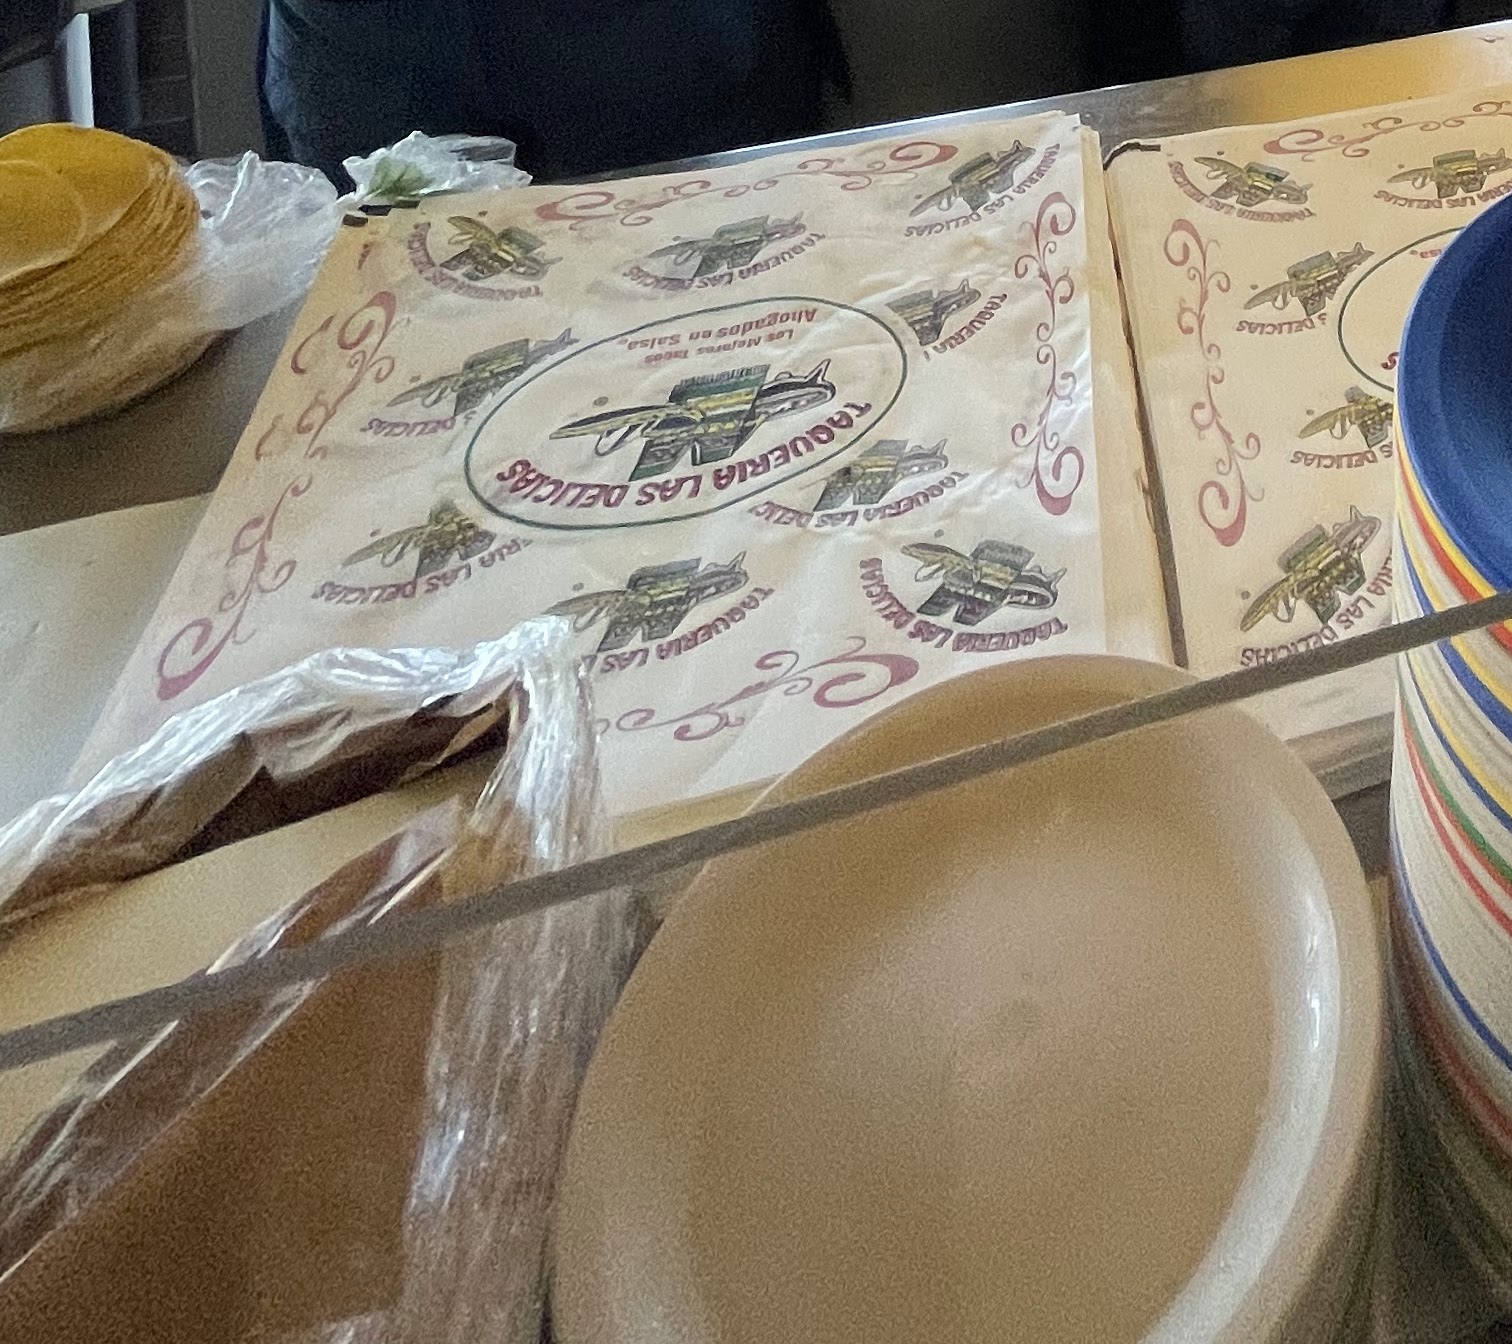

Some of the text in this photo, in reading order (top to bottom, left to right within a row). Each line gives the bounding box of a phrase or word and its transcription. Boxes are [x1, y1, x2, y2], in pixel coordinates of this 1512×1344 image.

[1373, 190, 1443, 210] DELICIAS
[904, 211, 981, 237] DELICIAS
[717, 309, 817, 339] Ahogados
[1236, 318, 1315, 336] DELICIAS
[495, 401, 872, 508] TAQUERIA LAS DELICIAS
[1290, 450, 1378, 469] DELICIAS
[424, 564, 471, 594] LAS
[1336, 595, 1375, 630] LAS
[600, 587, 775, 673] TAQUERIA LAS
